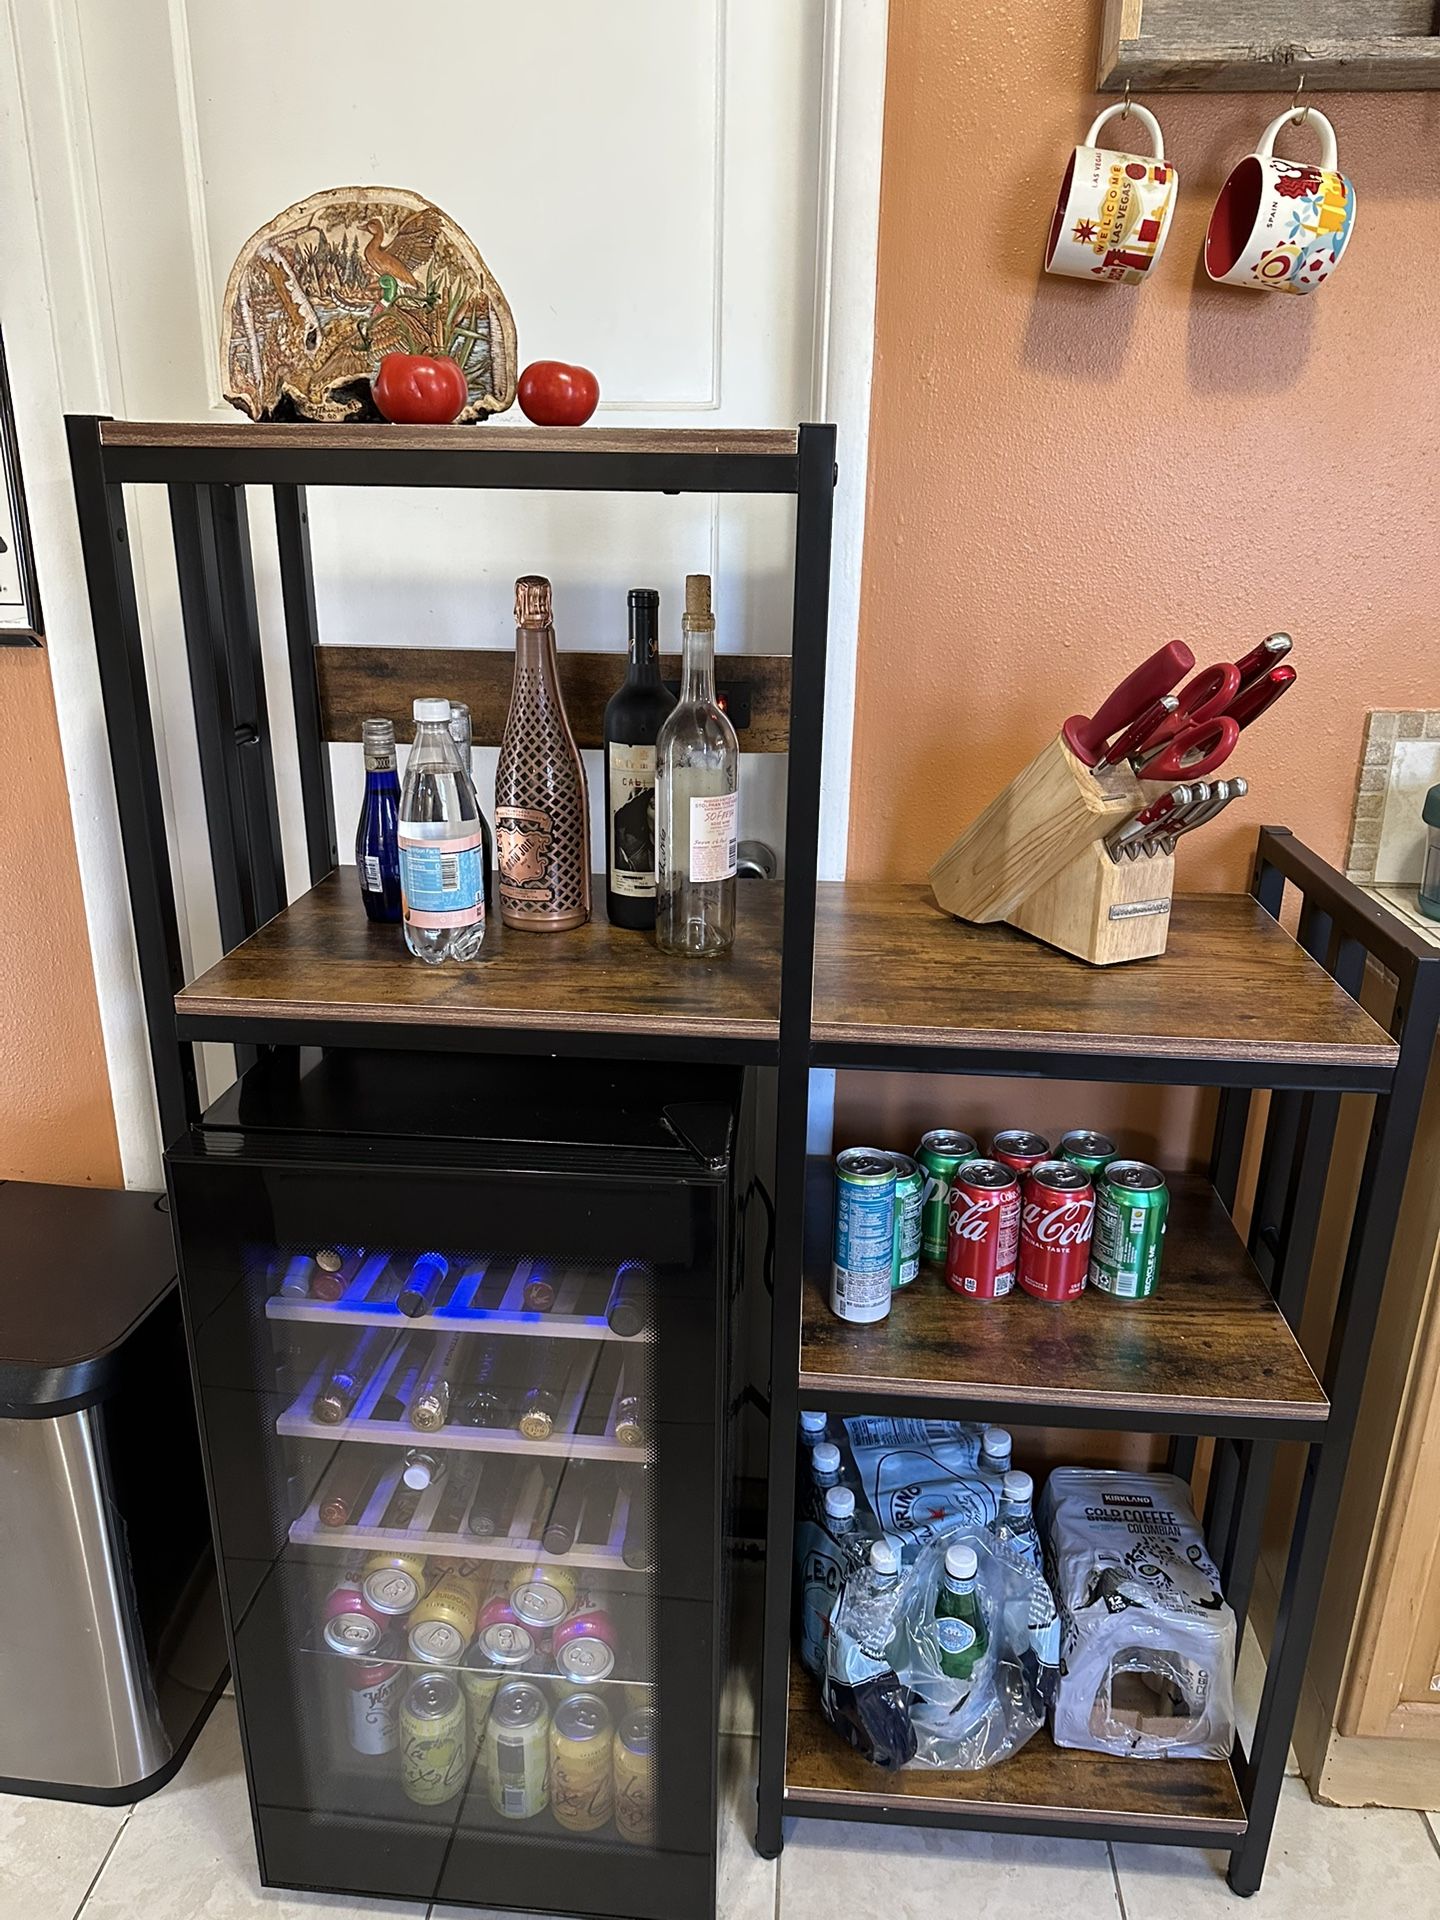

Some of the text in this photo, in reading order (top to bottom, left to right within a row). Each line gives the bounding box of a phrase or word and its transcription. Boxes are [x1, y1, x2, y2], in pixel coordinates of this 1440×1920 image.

[1091, 174, 1100, 188] LAS
[1096, 166, 1121, 253] WELCOME
[1111, 181, 1131, 244] LAS VEGAS
[1266, 201, 1279, 228] SPAIN
[1046, 1245, 1070, 1254] TASTE
[1143, 1258, 1156, 1296] RECYCLE
[1103, 1494, 1151, 1504] KIRKLAND
[1084, 1507, 1178, 1526] COLD COFFEE
[1127, 1523, 1182, 1537] COLOMBIAN
[1108, 1595, 1123, 1606] 12
